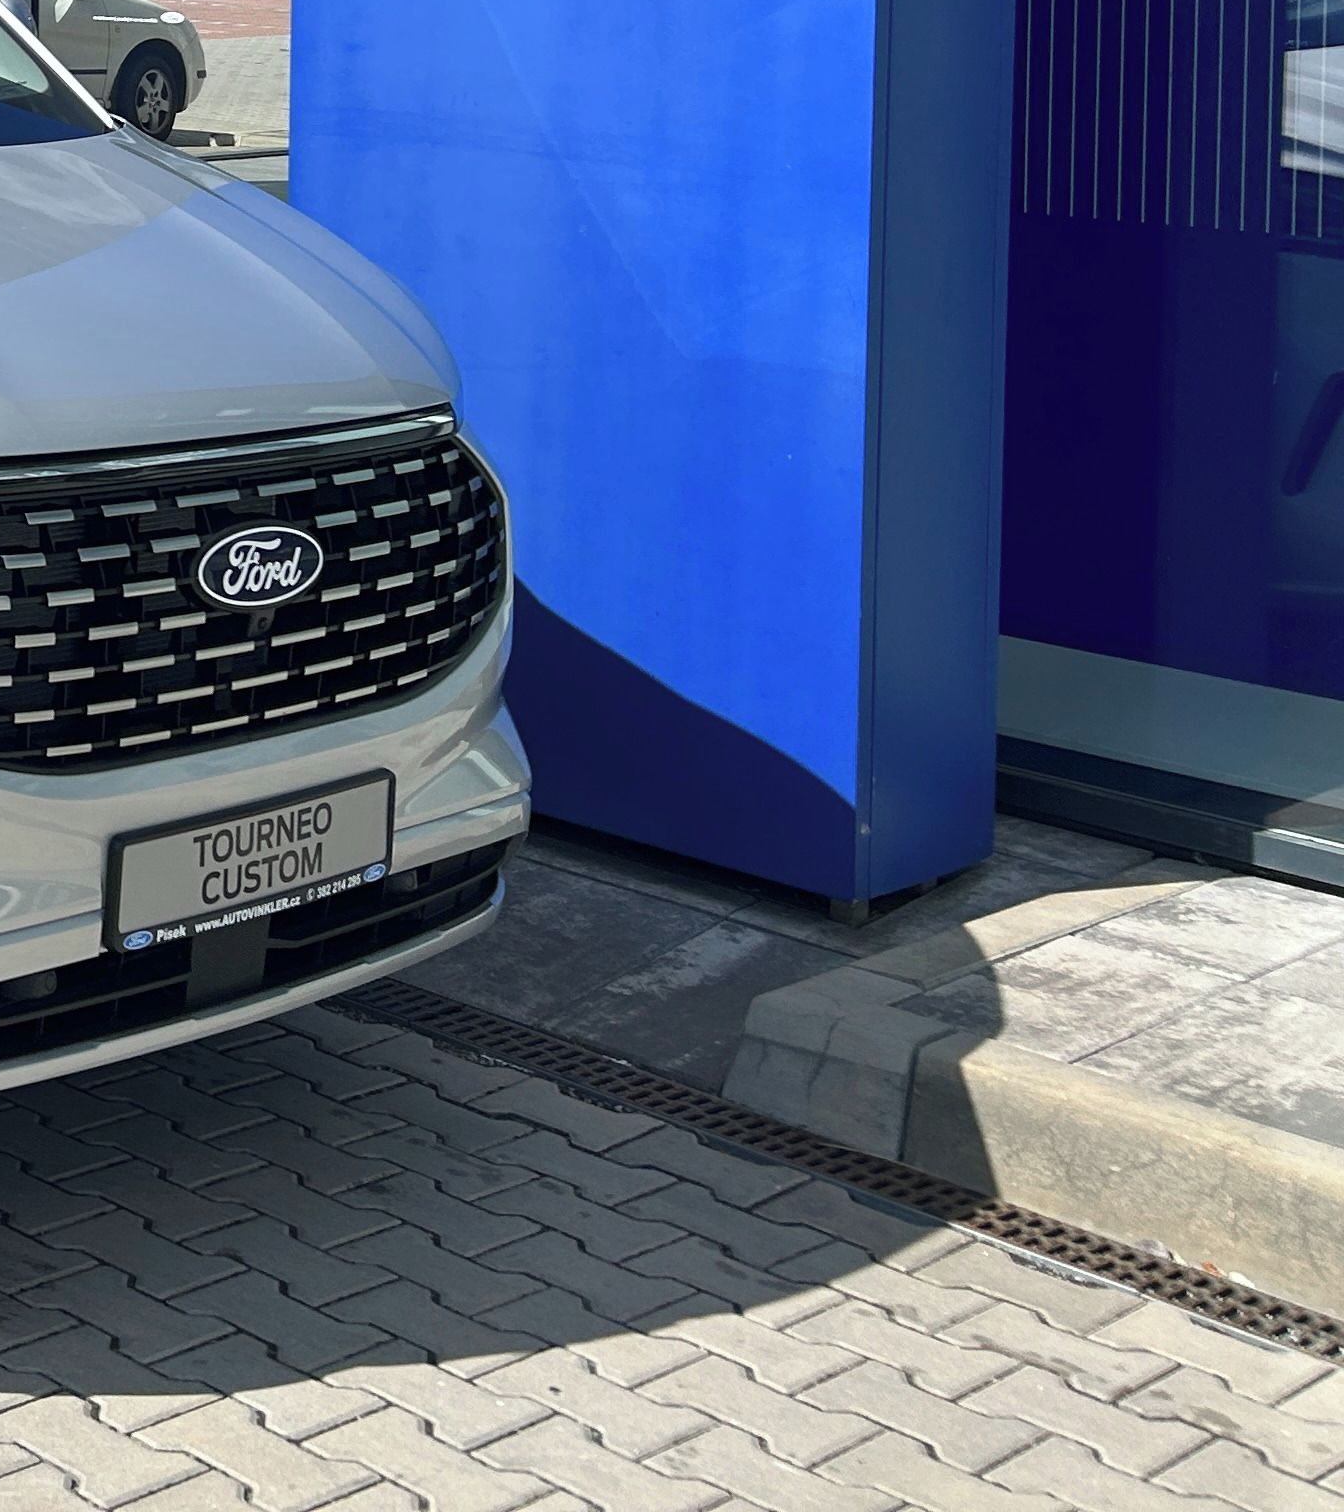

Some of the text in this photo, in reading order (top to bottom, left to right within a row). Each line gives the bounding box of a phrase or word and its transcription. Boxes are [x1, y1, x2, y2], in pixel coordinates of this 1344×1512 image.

[222, 537, 302, 596] Ford
[193, 802, 332, 867] TOURNEO
[201, 842, 323, 905] CUSTOM
